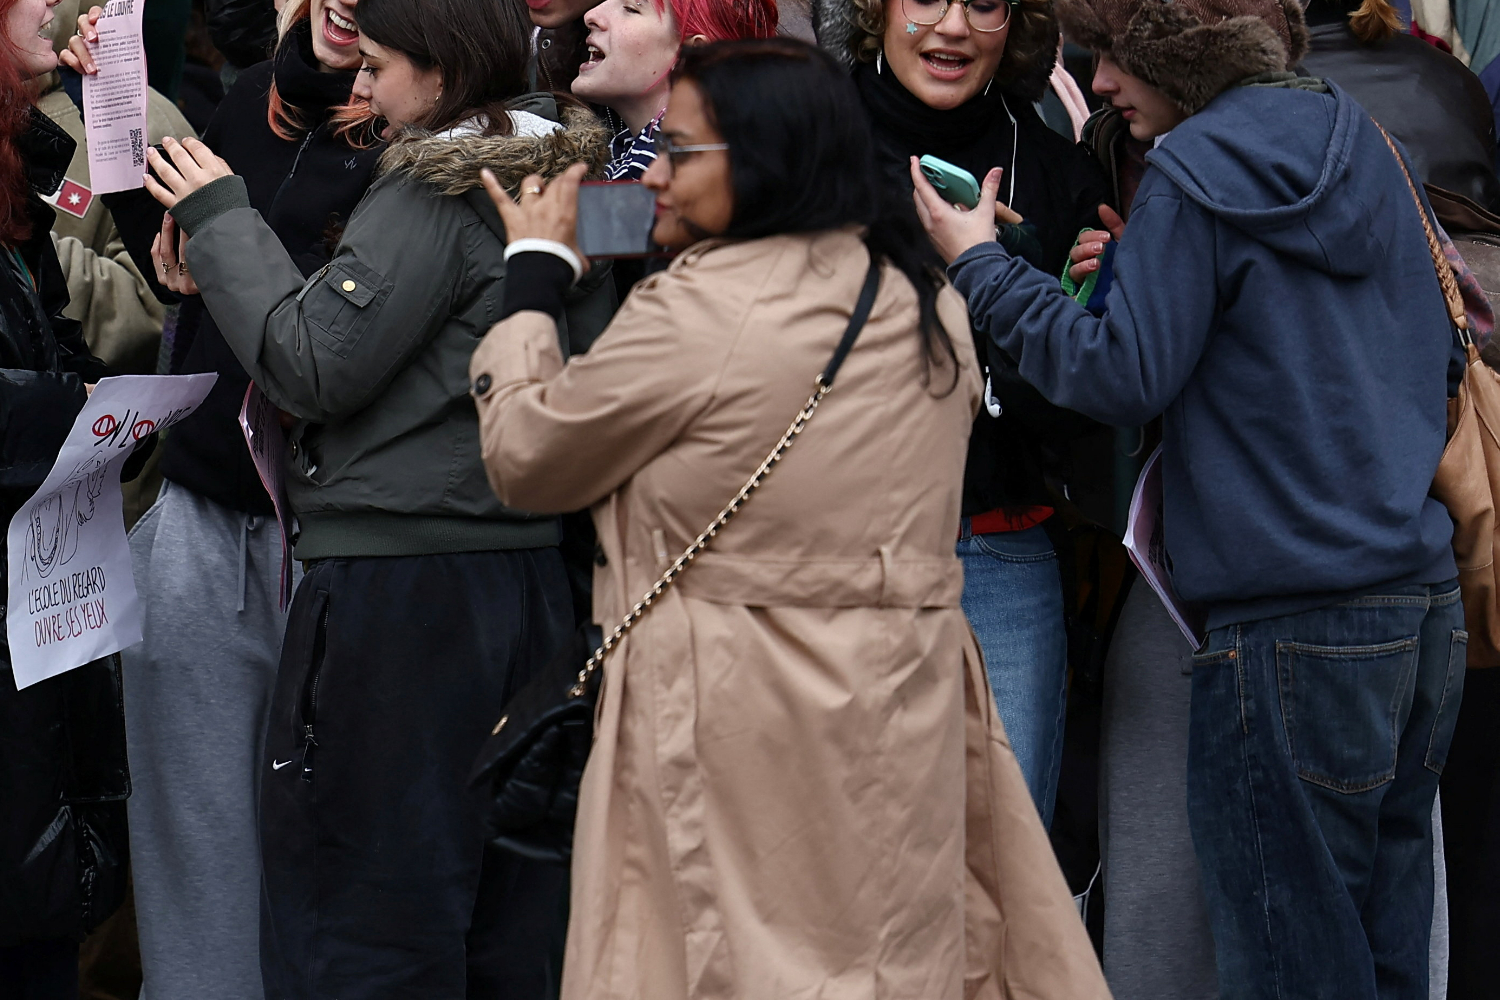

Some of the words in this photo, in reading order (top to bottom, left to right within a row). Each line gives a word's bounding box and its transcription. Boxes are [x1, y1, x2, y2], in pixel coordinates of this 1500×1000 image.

[107, 2, 114, 18] LE
[114, 0, 135, 17] LOUVRE
[28, 582, 60, 615] L'ECOLE
[60, 576, 72, 605] DU
[72, 566, 106, 601] REGARD
[34, 613, 65, 648] OUVRE
[65, 605, 83, 639] SES
[80, 597, 109, 630] YEUX
